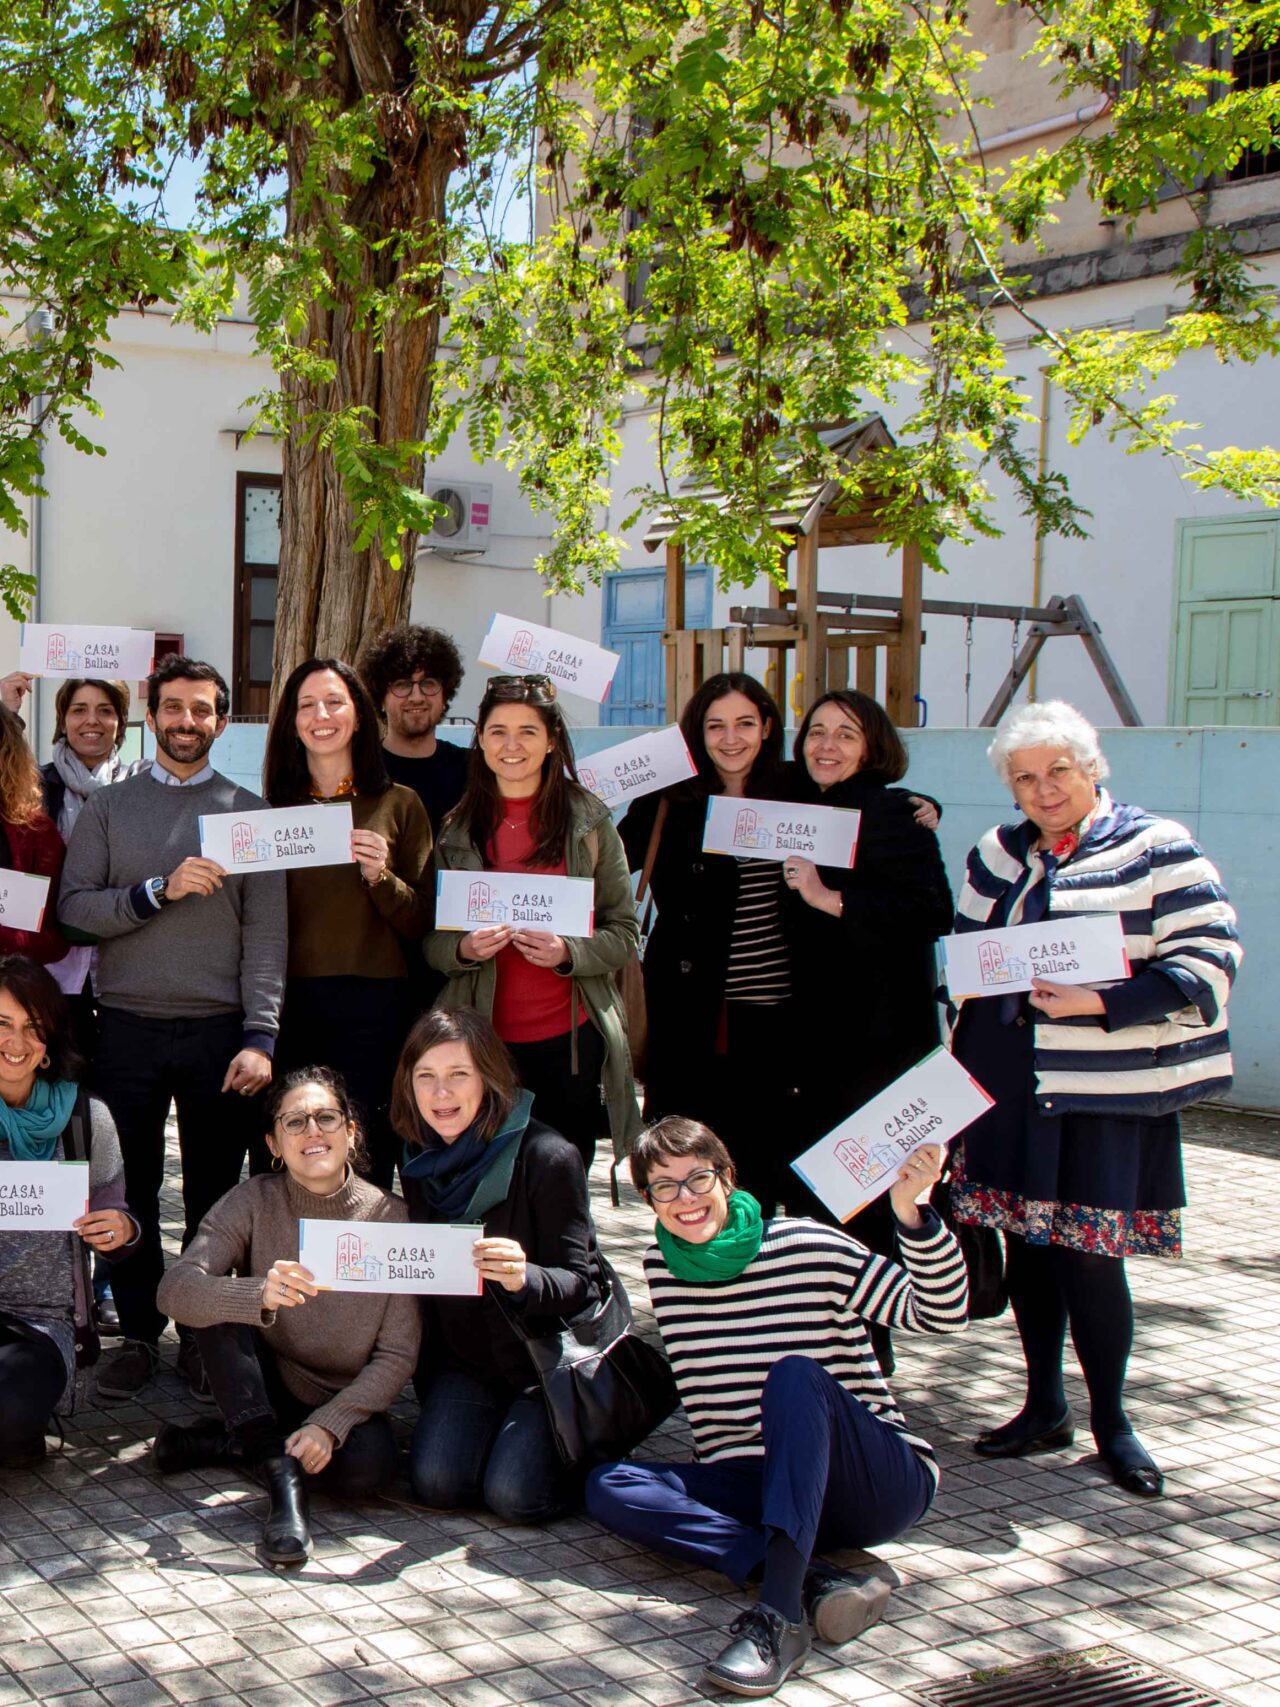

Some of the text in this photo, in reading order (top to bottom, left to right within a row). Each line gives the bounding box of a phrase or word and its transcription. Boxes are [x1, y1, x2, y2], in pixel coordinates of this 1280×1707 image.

[84, 657, 119, 669] Ballarò
[544, 662, 577, 681] Ballarò
[618, 770, 657, 791] Ballarò
[276, 843, 316, 857] Ballarò
[775, 836, 815, 851] Ballarò
[512, 909, 553, 922] Ballarò
[1032, 959, 1080, 976] Ballarò
[895, 1115, 943, 1153] Ballarò
[0, 1201, 44, 1217] Ballarò
[388, 1265, 436, 1280] Ballarò
